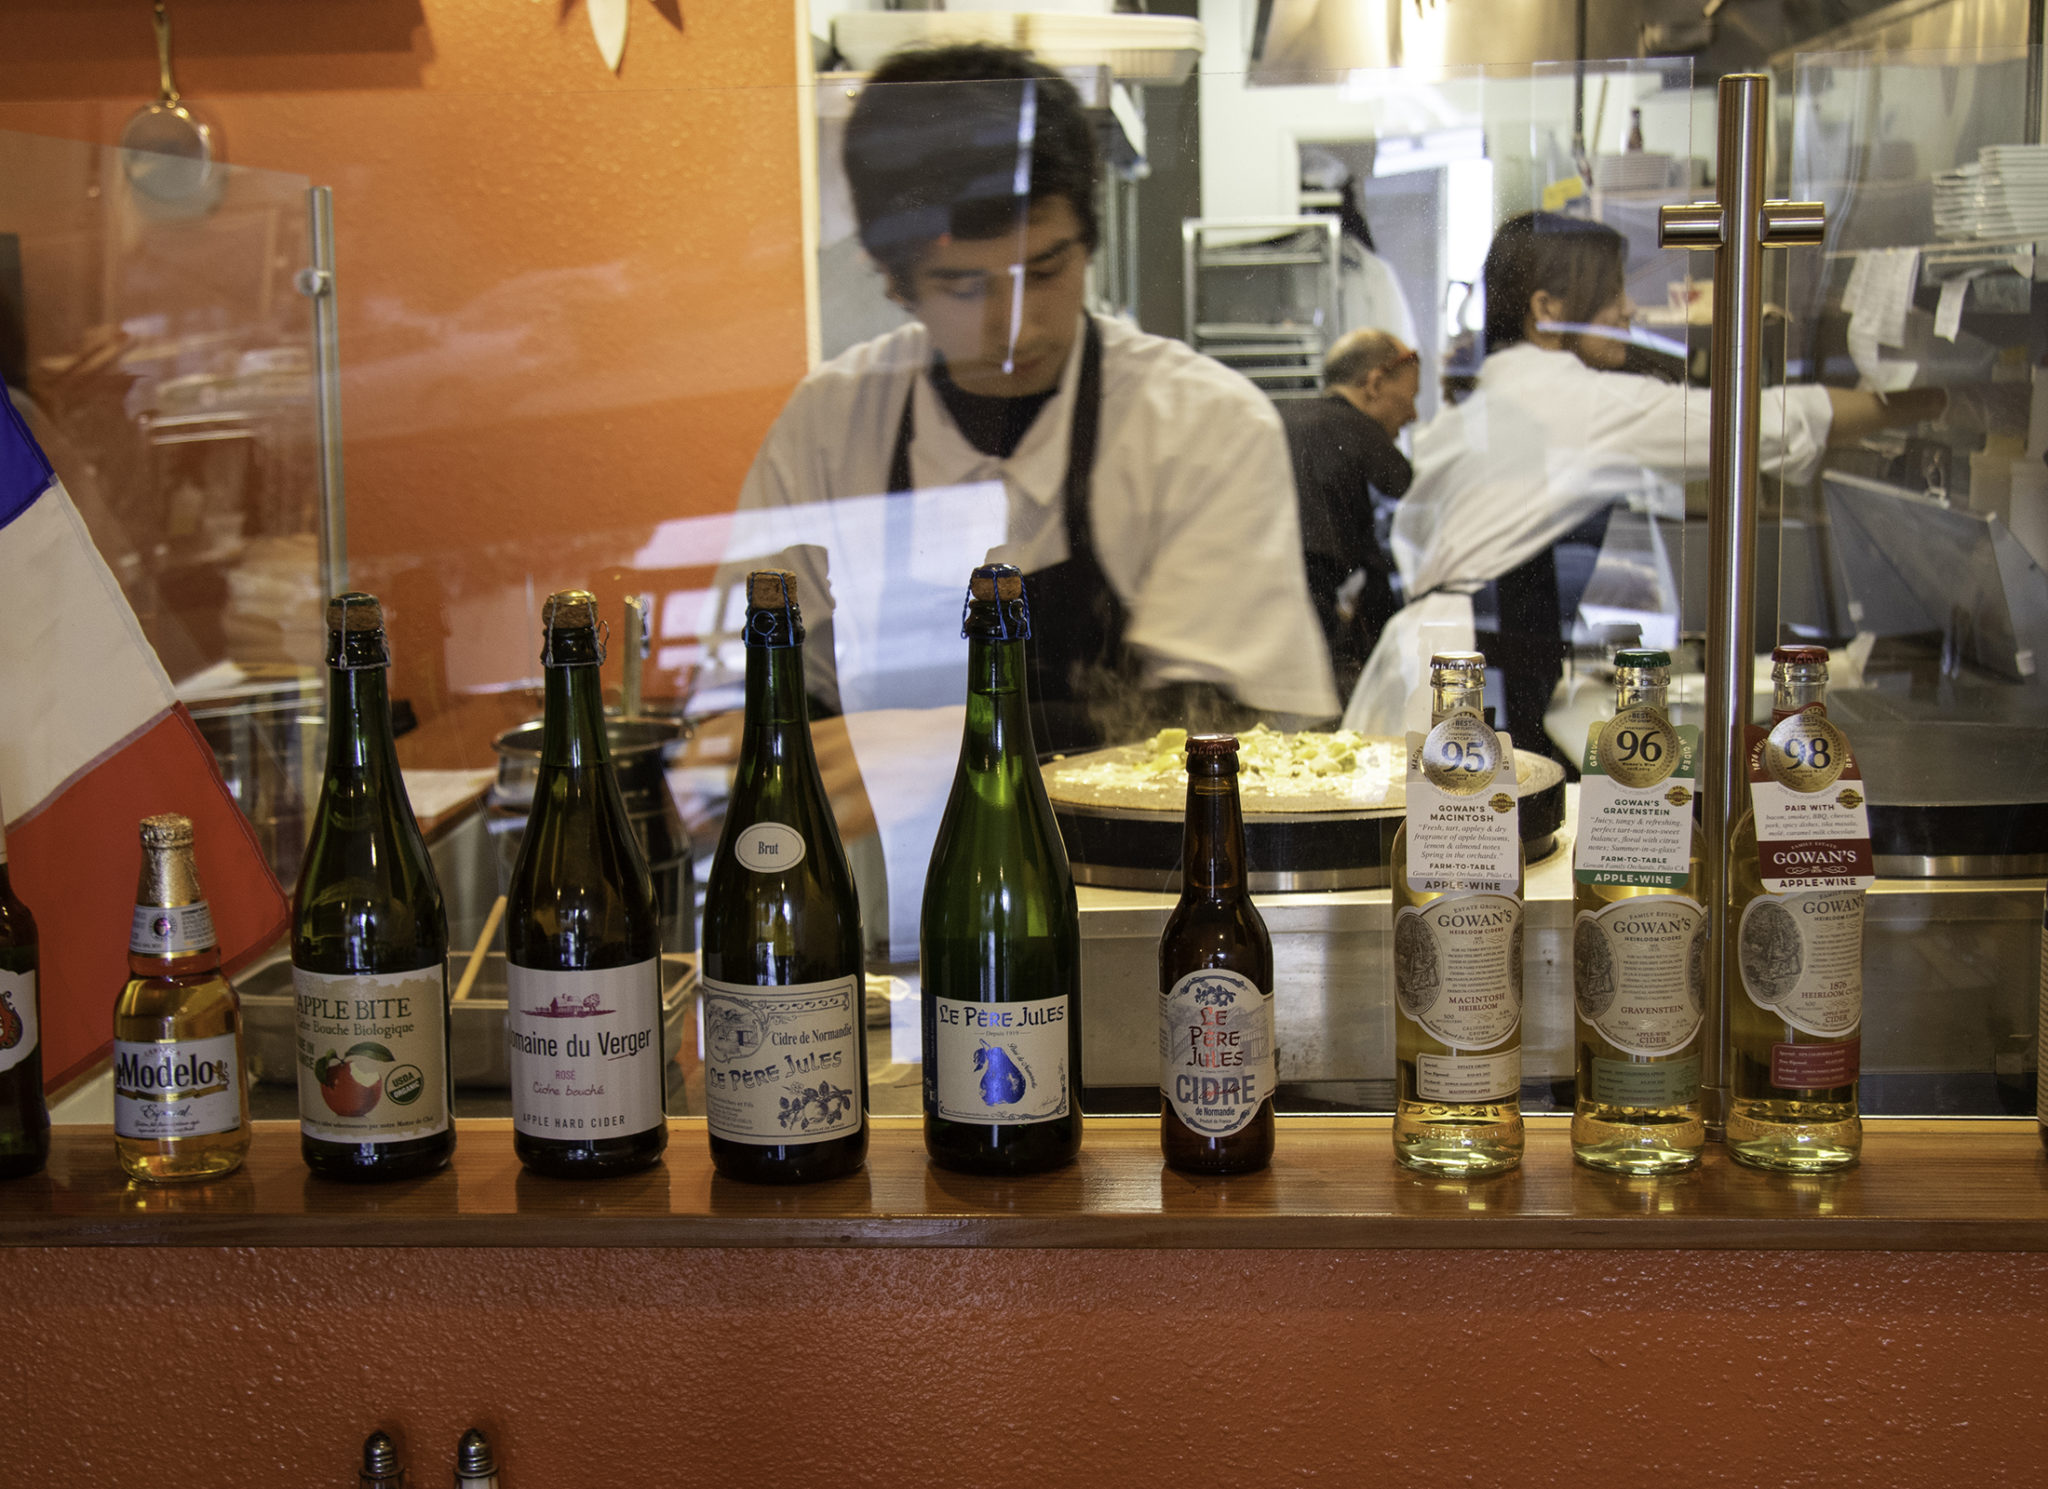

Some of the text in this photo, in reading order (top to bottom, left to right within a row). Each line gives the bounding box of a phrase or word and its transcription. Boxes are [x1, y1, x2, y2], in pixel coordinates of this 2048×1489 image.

[1616, 730, 1662, 761] 96
[1784, 738, 1831, 769] 98
[1442, 741, 1484, 772] 95
[1681, 746, 1691, 771] CIDER
[1430, 814, 1494, 822] MACINTOSH
[758, 841, 778, 854] Brut
[1421, 851, 1444, 859] Spring
[1773, 850, 1856, 864] GOWAN'S
[1425, 881, 1500, 891] APPLE-WINE
[1594, 874, 1672, 884] APPLE-WINE
[1780, 878, 1856, 888] APPLE-WINE
[1438, 910, 1512, 927] GOWAN'S
[1613, 918, 1691, 934] GOWAN'S
[1830, 981, 1847, 990] 1876
[1449, 993, 1505, 1004] MACINTOSH
[356, 998, 412, 1020] BITE
[1459, 1003, 1498, 1011] HEIRLOOM
[1621, 1005, 1683, 1014] GRAVENSTEIN
[939, 1004, 1064, 1027] LE PÈRE JULES
[1200, 1007, 1227, 1026] LE
[1826, 1015, 1848, 1023] CIDER
[354, 1022, 415, 1038] Biologique
[771, 1023, 852, 1046] Cidre de Normandie
[1189, 1025, 1240, 1048] PÈRE
[512, 1030, 558, 1057] omaine
[567, 1028, 651, 1058] du Verger
[1186, 1046, 1244, 1068] JULES
[121, 1052, 214, 1088] Modelo
[710, 1051, 842, 1092] LE PÈRE JULES
[392, 1073, 415, 1087] USDA
[393, 1078, 422, 1099] ORGANIC
[533, 1081, 605, 1097] Cidre bouché
[1176, 1074, 1256, 1106] CIDRE
[1204, 1107, 1235, 1116] Normandie
[523, 1113, 625, 1128] APPLE HARD CIDER
